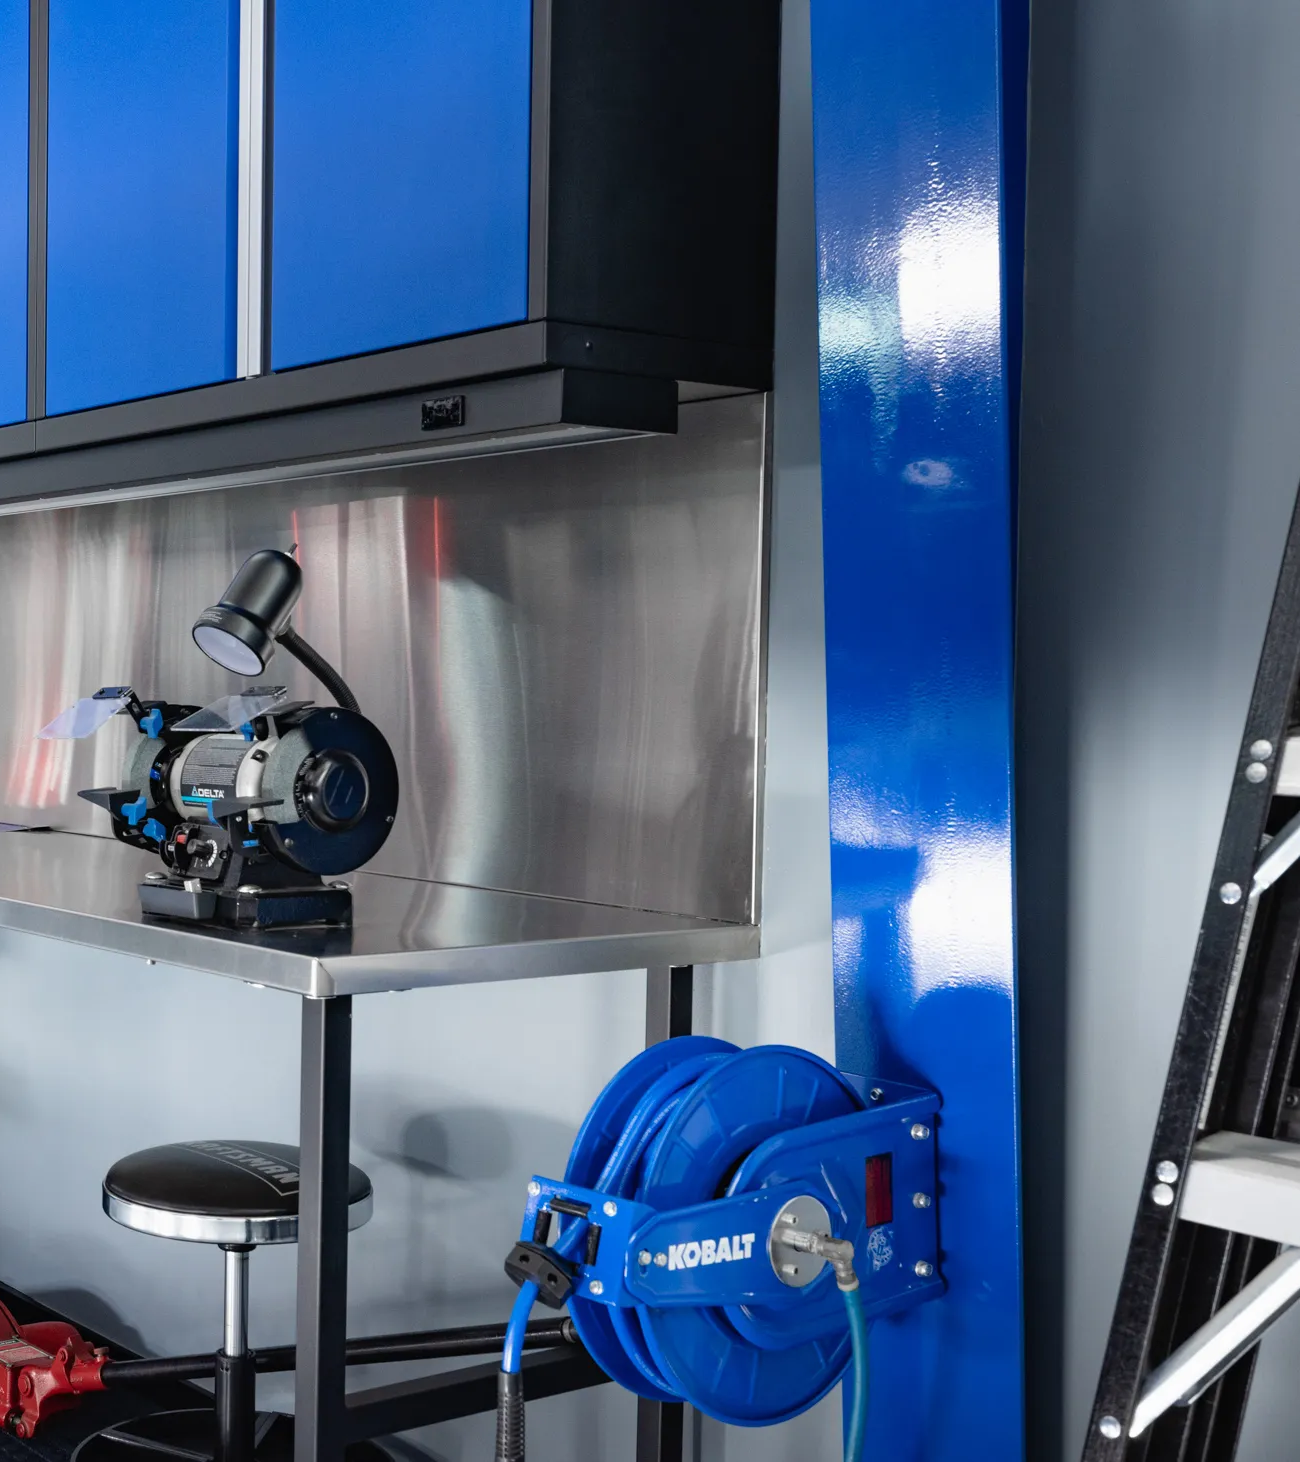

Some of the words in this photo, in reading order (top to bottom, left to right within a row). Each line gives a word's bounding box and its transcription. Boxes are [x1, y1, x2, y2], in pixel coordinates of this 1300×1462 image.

[197, 787, 225, 799] DELTA
[181, 1140, 300, 1184] RAFTSMAN
[668, 1232, 756, 1271] KOBALT
